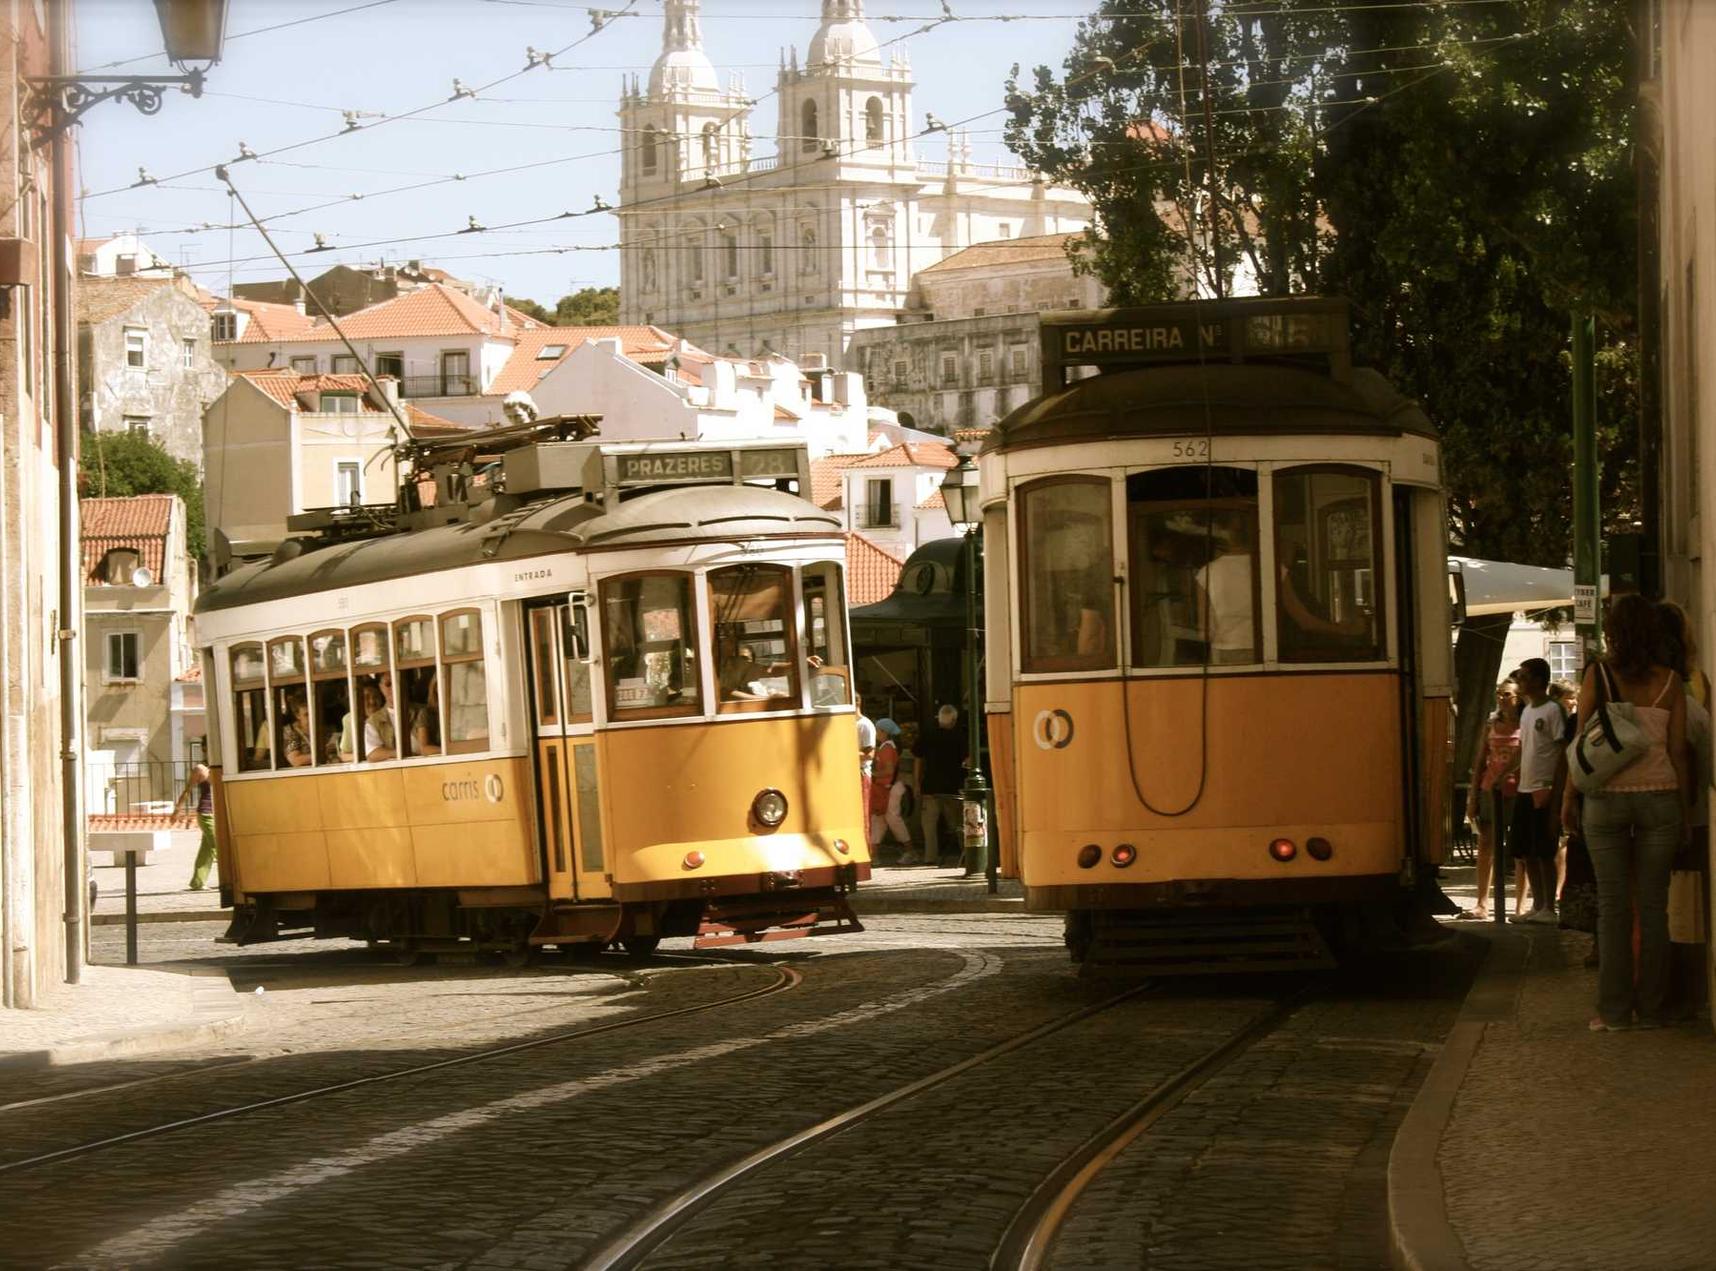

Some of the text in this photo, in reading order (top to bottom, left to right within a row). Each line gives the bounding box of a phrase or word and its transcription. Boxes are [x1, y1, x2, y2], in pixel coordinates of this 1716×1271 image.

[1065, 327, 1184, 353] CARREIRA
[1173, 440, 1208, 457] 562
[626, 453, 784, 476] PRAZERES 28
[514, 568, 553, 582] ENTRADA
[442, 774, 480, 801] carris
